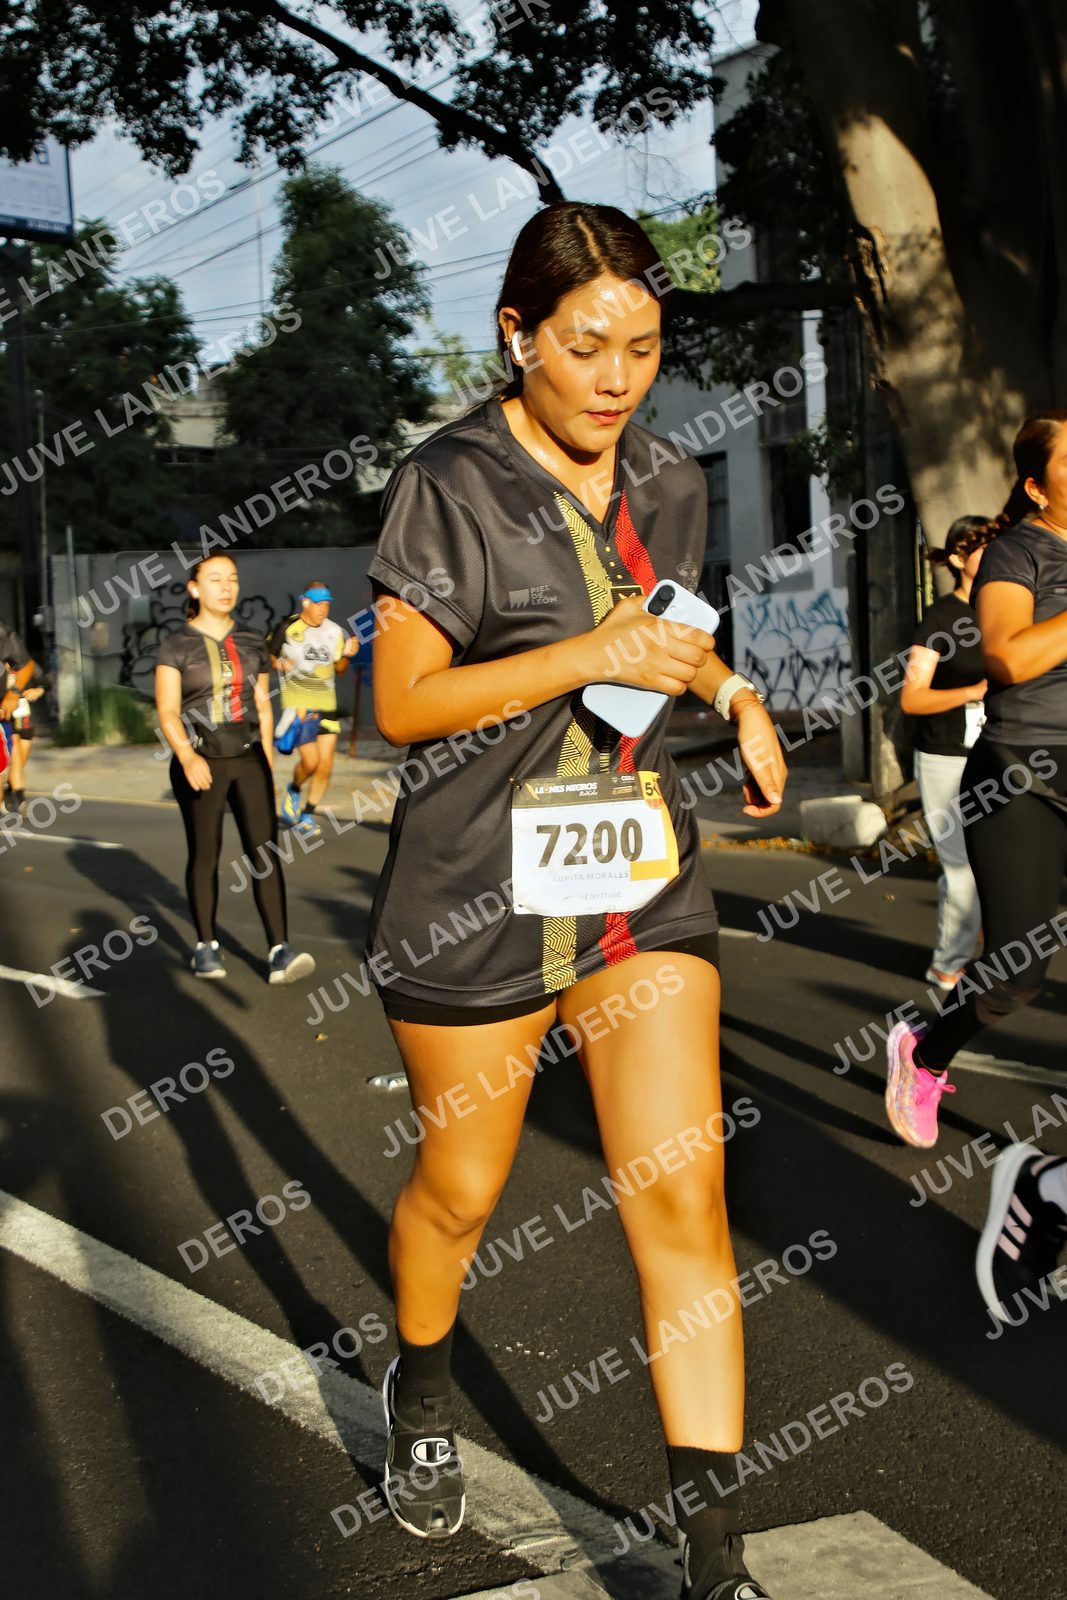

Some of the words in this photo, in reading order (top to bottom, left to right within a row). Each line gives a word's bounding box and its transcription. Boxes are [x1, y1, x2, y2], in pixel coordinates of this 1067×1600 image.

[530, 584, 551, 594] PIEL
[531, 591, 544, 600] DE
[535, 818, 643, 868] 7200
[586, 870, 629, 881] MORALES
